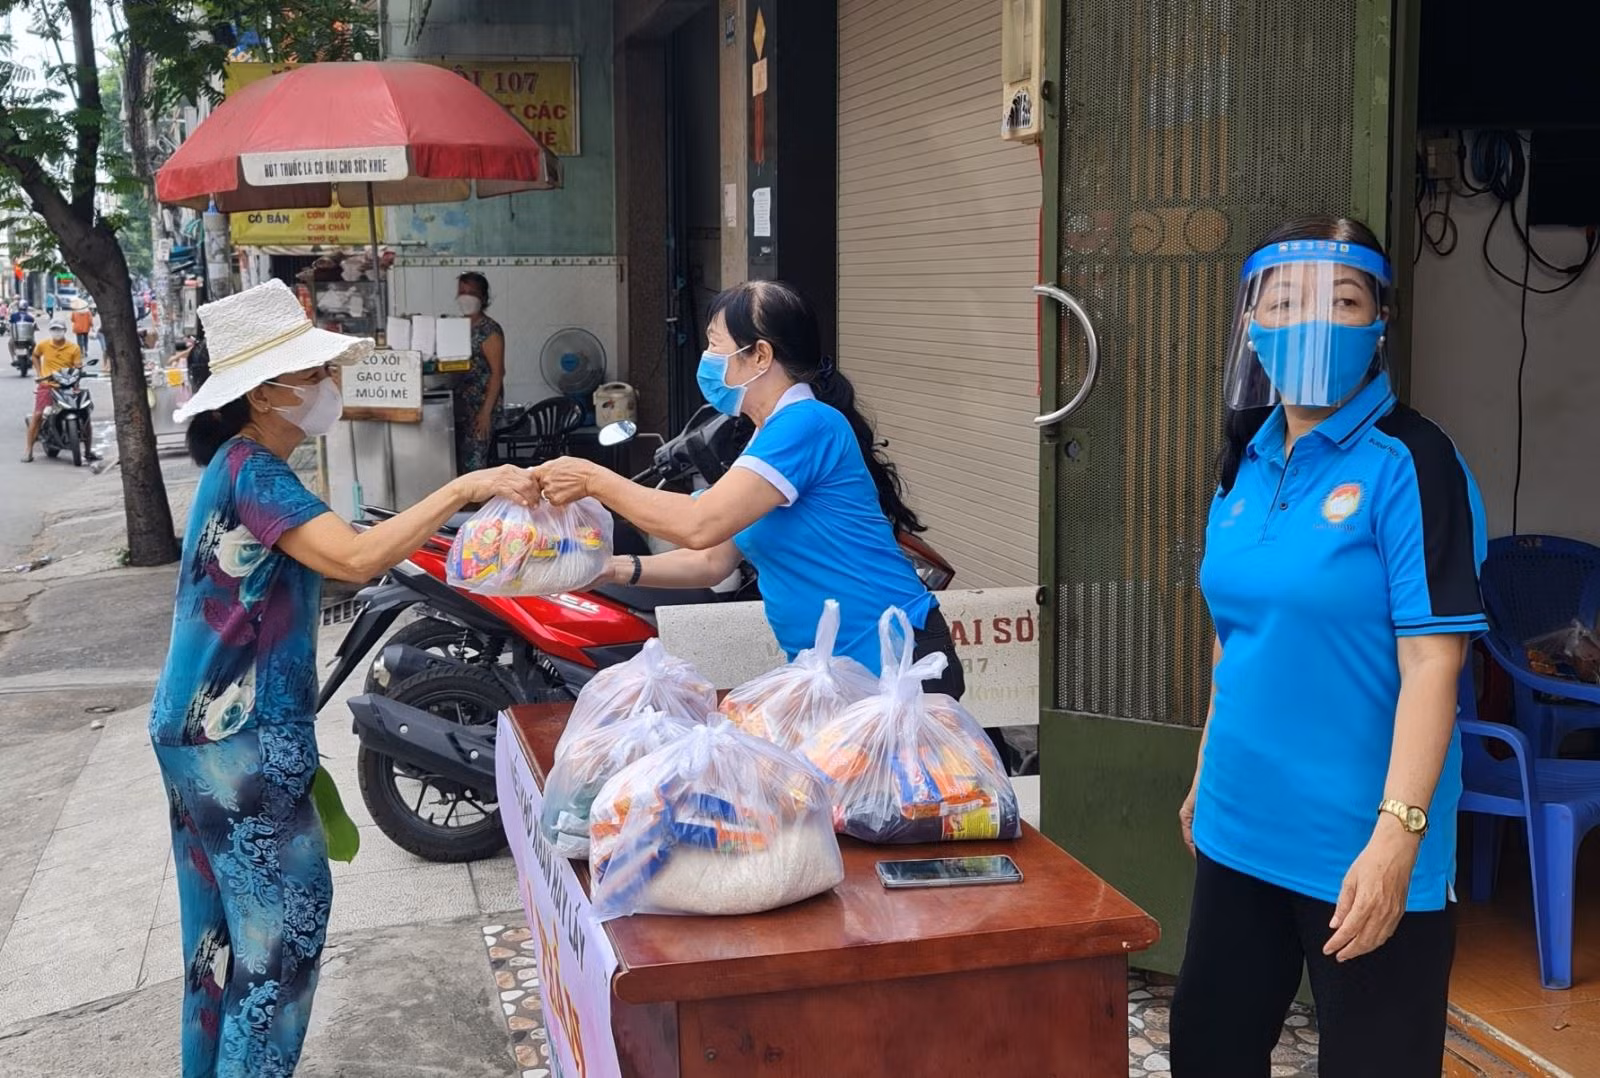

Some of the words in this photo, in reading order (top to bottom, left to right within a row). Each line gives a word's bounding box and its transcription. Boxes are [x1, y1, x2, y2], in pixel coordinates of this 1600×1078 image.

[495, 72, 538, 94] 107
[523, 101, 567, 120] CÁC
[340, 160, 352, 174] CHO
[248, 211, 262, 224] CÓ
[267, 211, 290, 225] BÁN
[382, 353, 400, 366] XÔI
[356, 371, 382, 384] GẠO
[385, 370, 407, 382] LỨC
[356, 385, 388, 399] MUỐI
